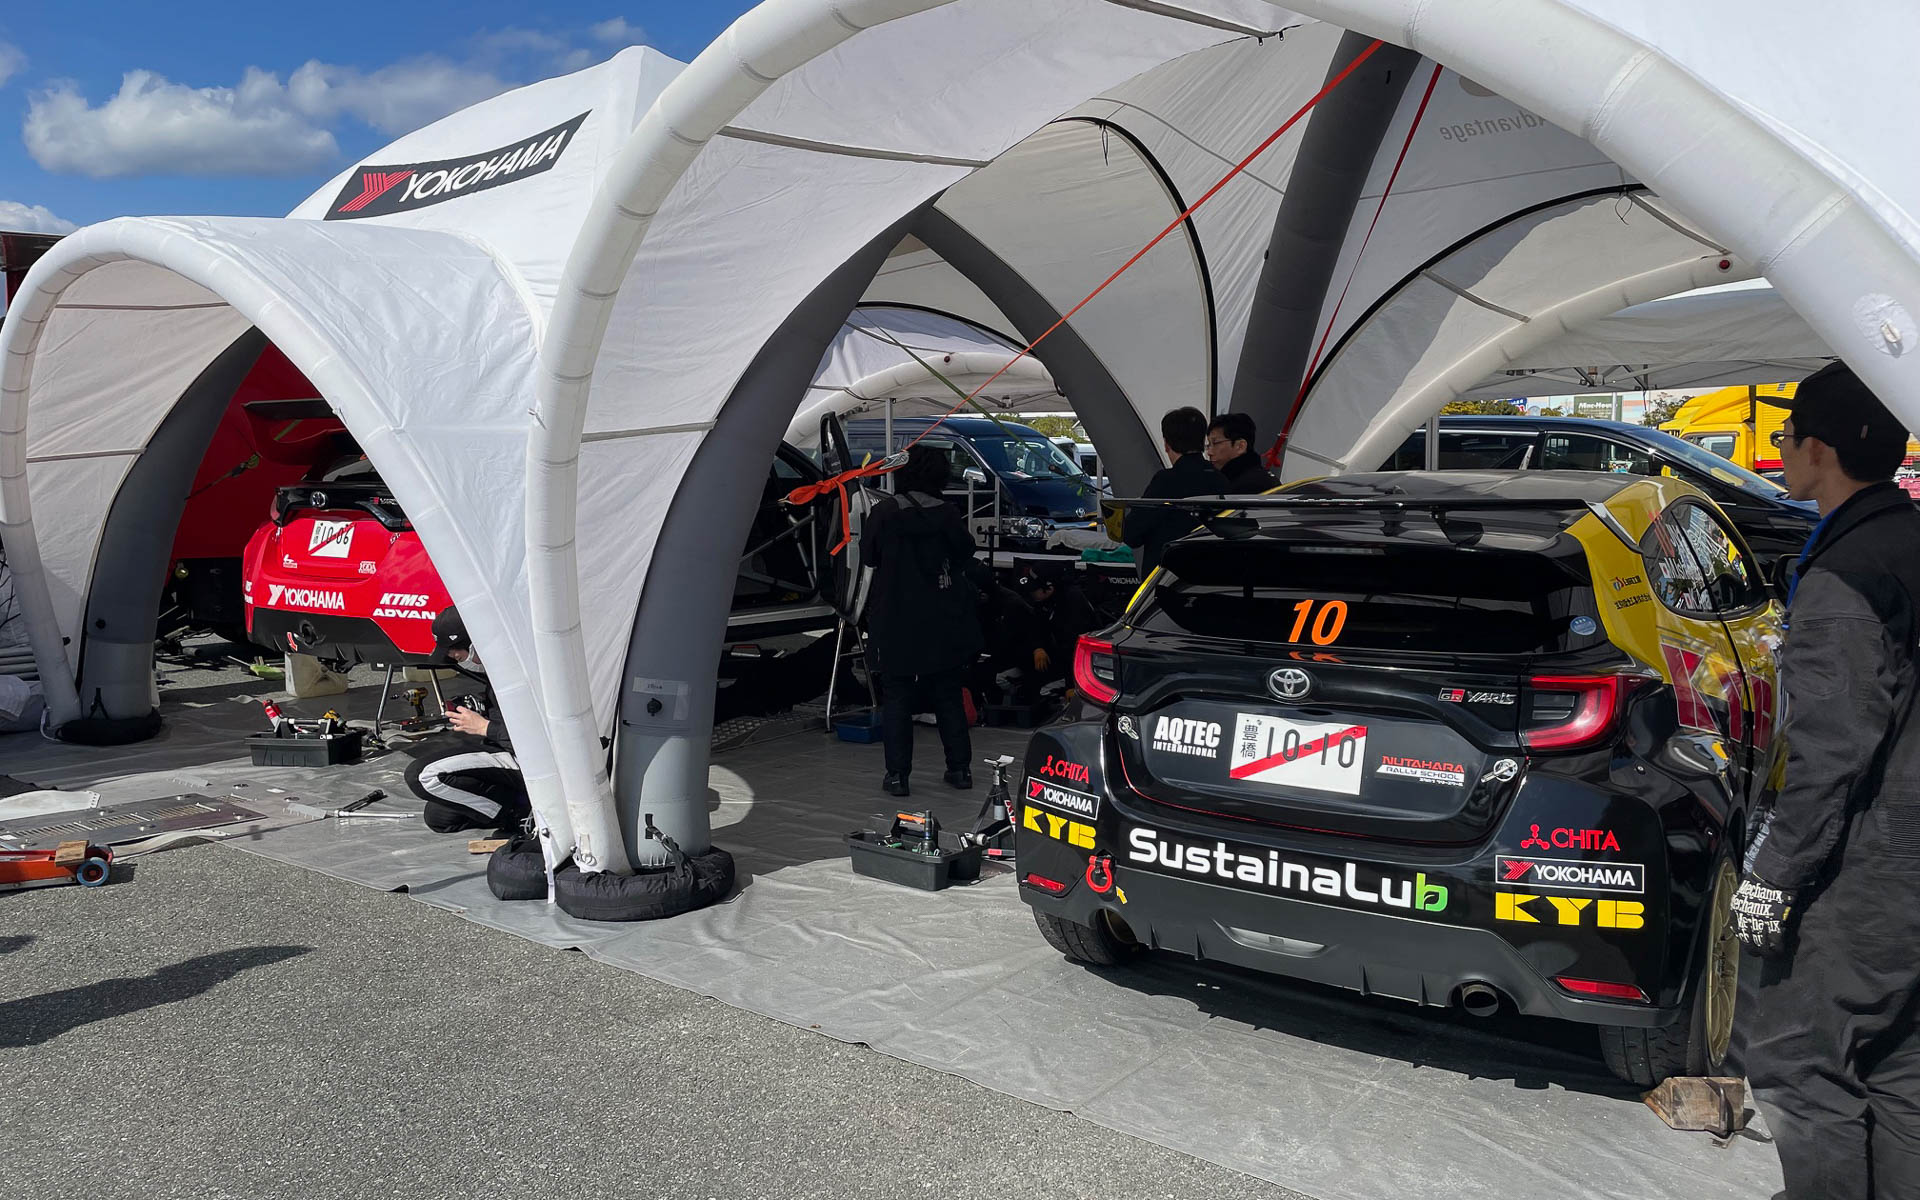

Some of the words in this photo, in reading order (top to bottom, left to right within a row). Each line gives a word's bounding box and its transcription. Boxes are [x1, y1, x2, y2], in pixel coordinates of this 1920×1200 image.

[398, 129, 568, 202] YOKOHAMA
[284, 590, 345, 610] YOKOHAMA
[379, 592, 430, 607] KTMS
[372, 608, 436, 620] ADVAN
[1287, 599, 1349, 645] 10
[1440, 693, 1463, 702] GR
[1467, 690, 1517, 705] YARIS
[1153, 716, 1222, 748] AQTEC
[1240, 723, 1259, 760] 豊橋
[1152, 740, 1217, 759] INTERNATIONAL
[1265, 725, 1357, 769] 10-10
[1055, 760, 1090, 785] CHITA
[1381, 755, 1465, 773] NUTAHARA
[1385, 766, 1418, 776] RALLY
[1420, 770, 1460, 780] SCHOOL
[1043, 784, 1095, 814] YOKOHAMA
[1023, 804, 1097, 850] KYB
[1551, 828, 1621, 852] CHITA
[1128, 827, 1449, 913] SustainaLub
[1533, 865, 1636, 886] YOKOHAMA
[1494, 891, 1645, 930] KYB
